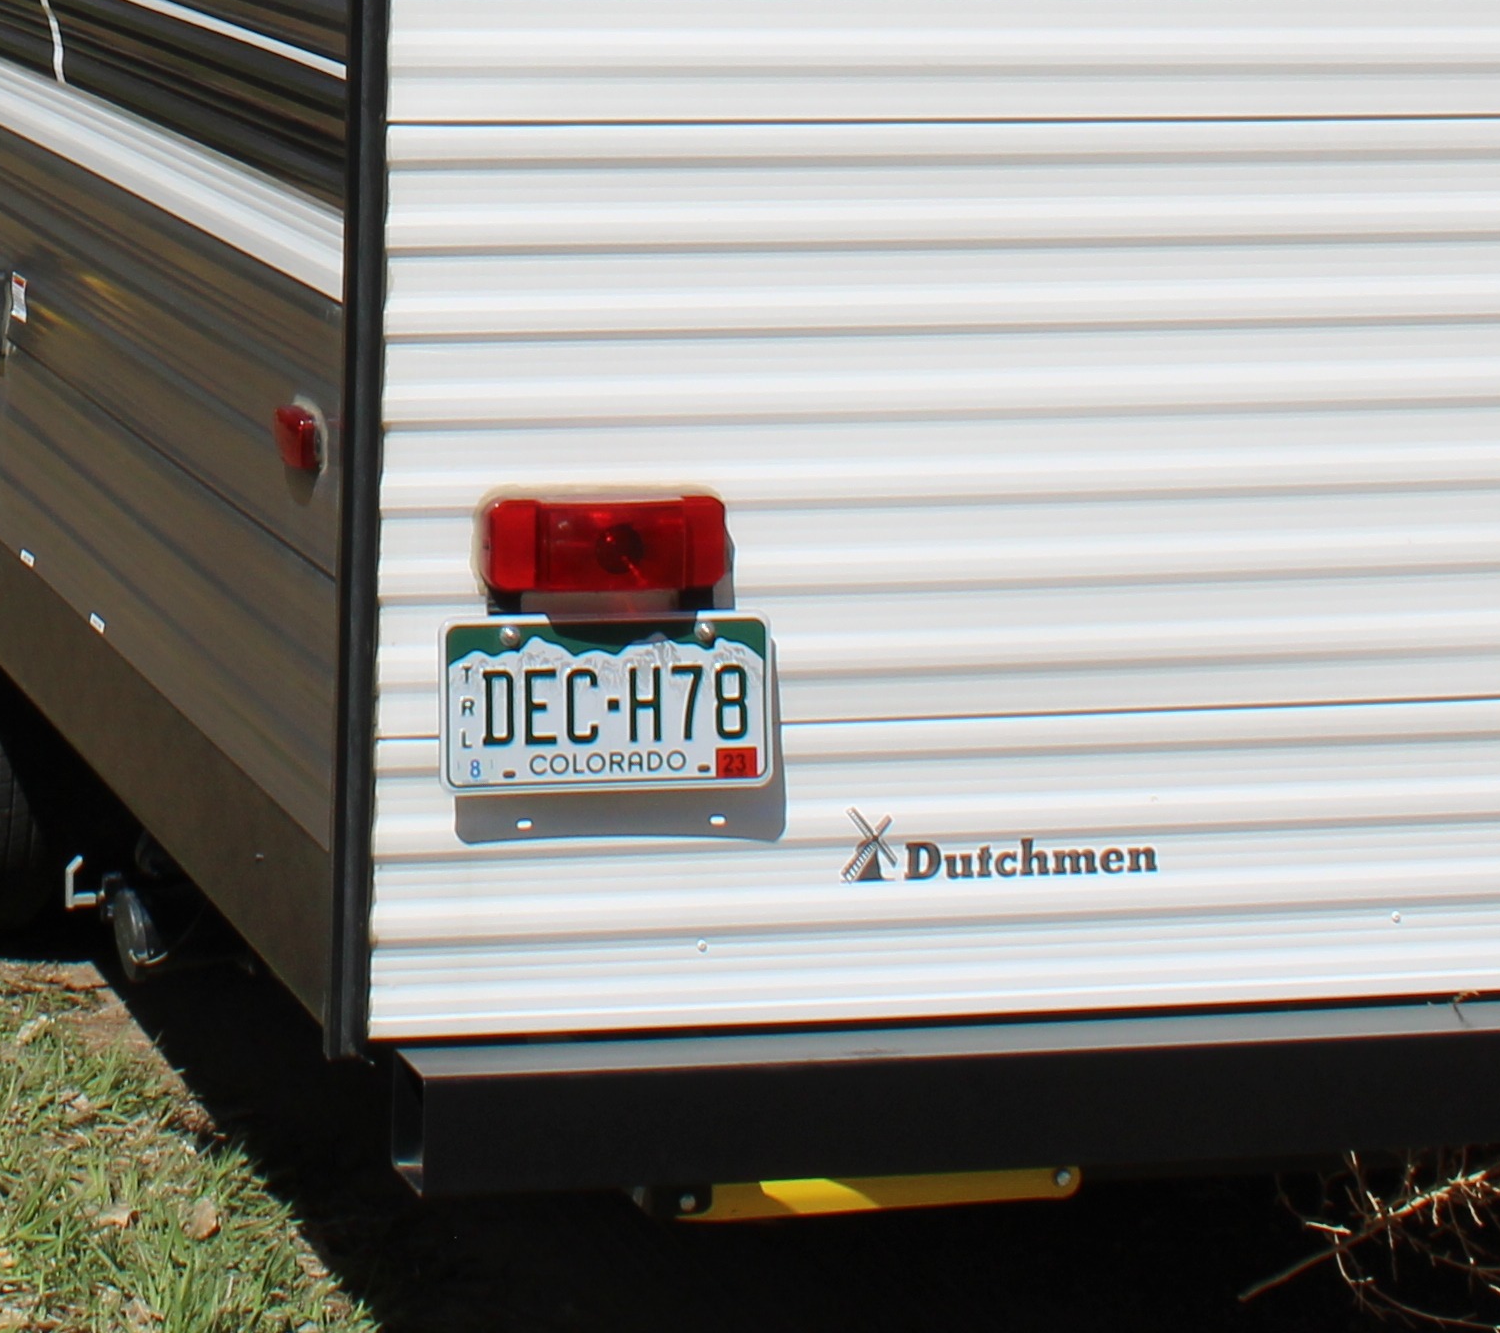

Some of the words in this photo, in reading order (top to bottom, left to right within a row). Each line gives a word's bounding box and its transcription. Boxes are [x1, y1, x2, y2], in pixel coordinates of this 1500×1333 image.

[469, 758, 481, 778] 8
[529, 750, 687, 776] COLORADO
[722, 753, 747, 773] 23
[903, 837, 1158, 881] Dutchmen
